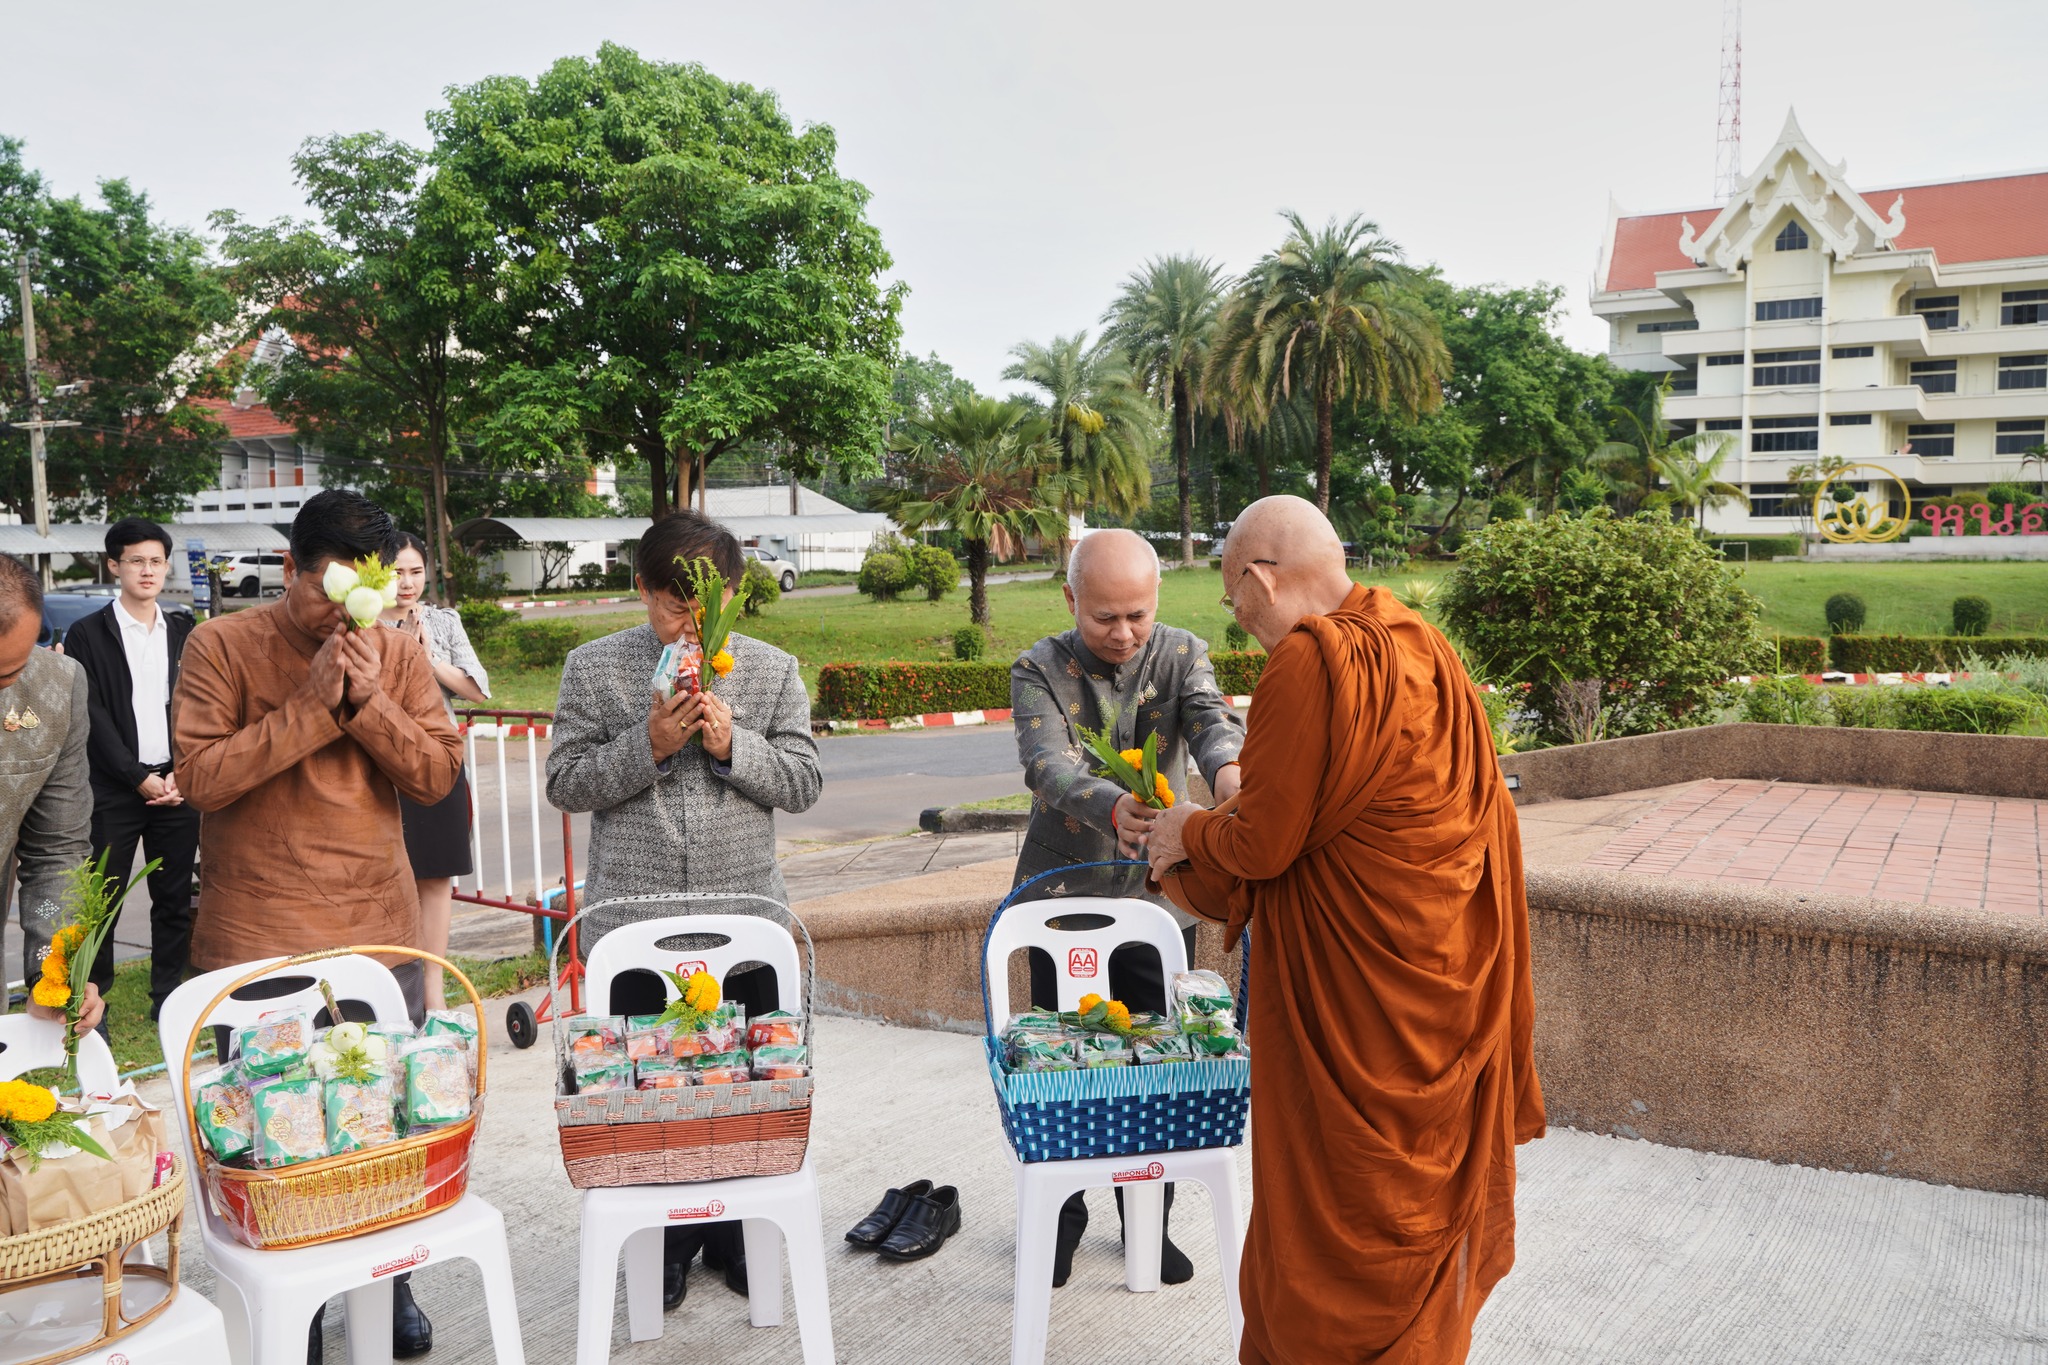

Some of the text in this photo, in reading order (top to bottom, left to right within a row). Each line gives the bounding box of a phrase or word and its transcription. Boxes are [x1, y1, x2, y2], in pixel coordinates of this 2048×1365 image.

[1071, 953, 1095, 967] AA
[1150, 1165, 1161, 1175] 12
[710, 1202, 721, 1213] 12
[415, 1247, 426, 1260] 12
